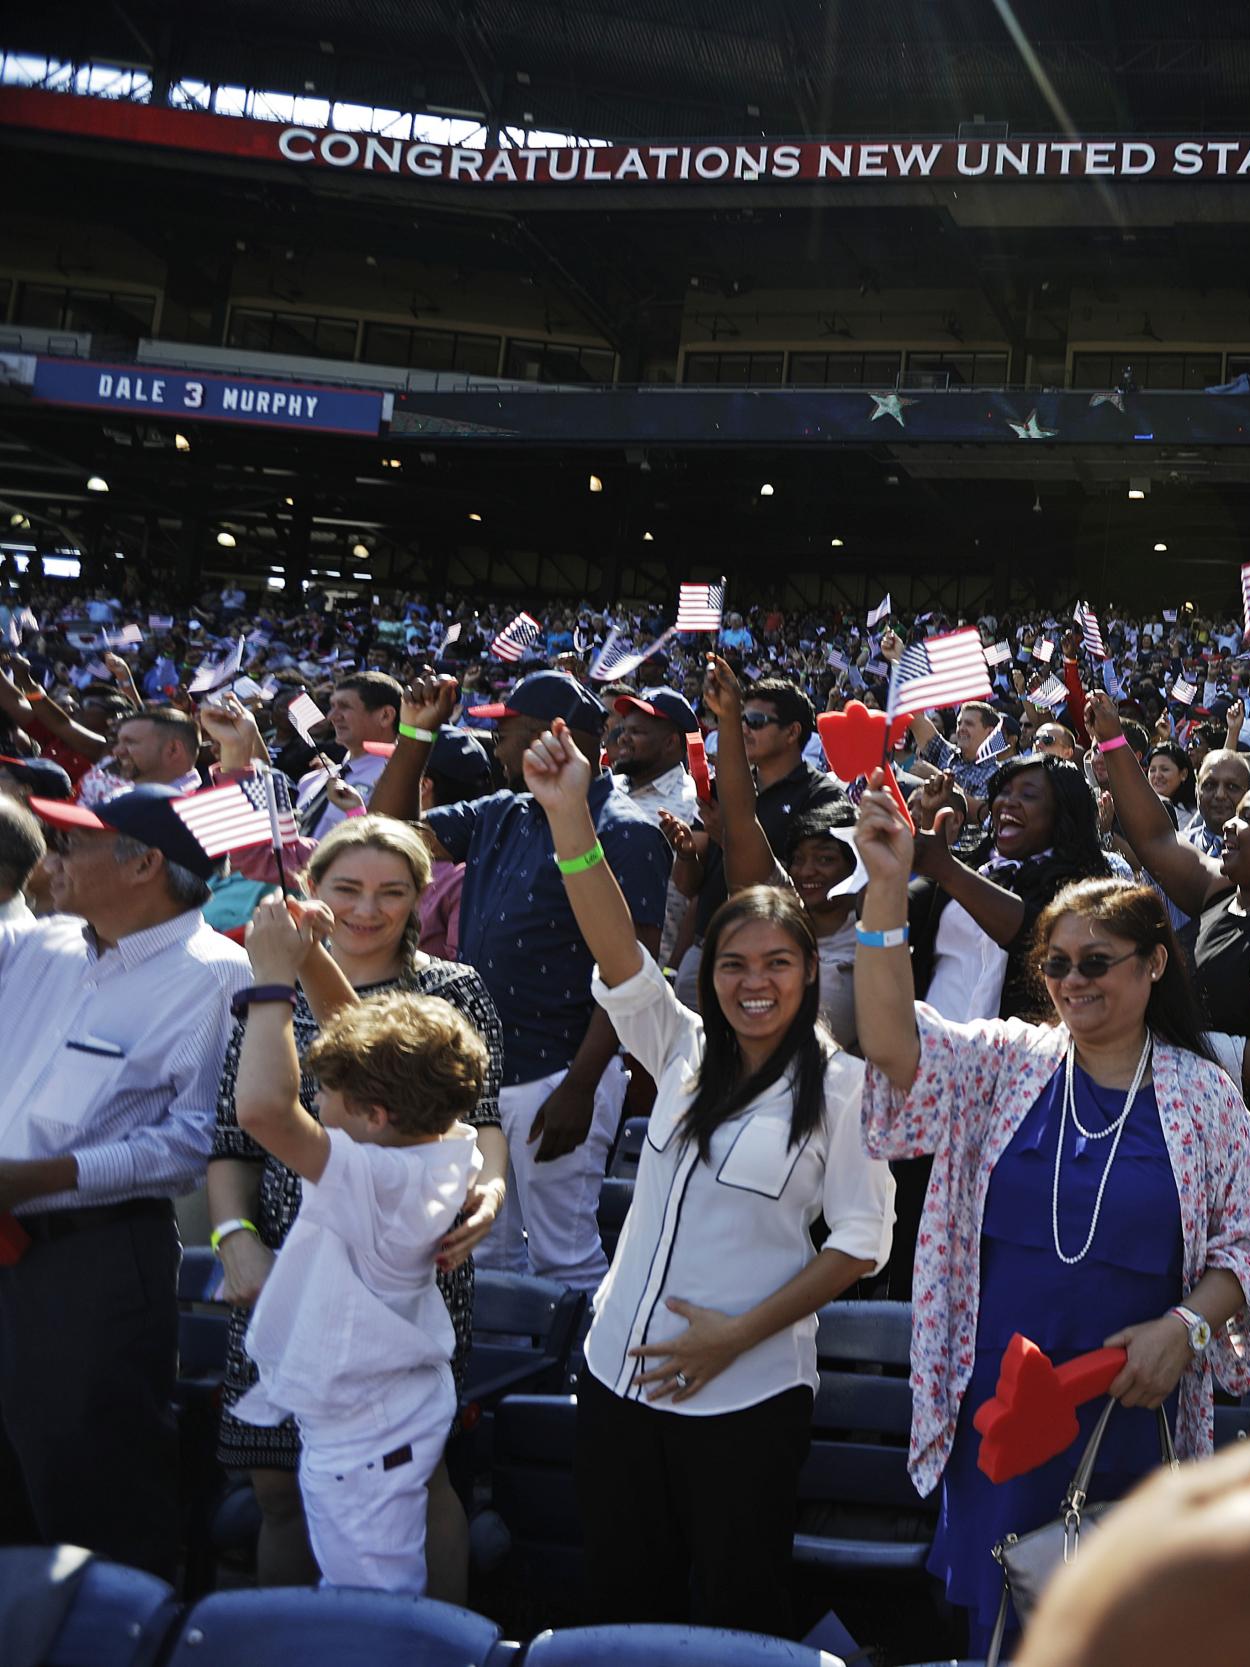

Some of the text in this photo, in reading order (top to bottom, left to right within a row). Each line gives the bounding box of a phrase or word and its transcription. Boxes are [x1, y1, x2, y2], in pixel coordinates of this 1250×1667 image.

[278, 126, 801, 181] CONGRATULATIONS
[817, 143, 942, 177] NEW
[956, 142, 1156, 176] UNITED
[98, 374, 318, 418] DALE 3 MURPHY
